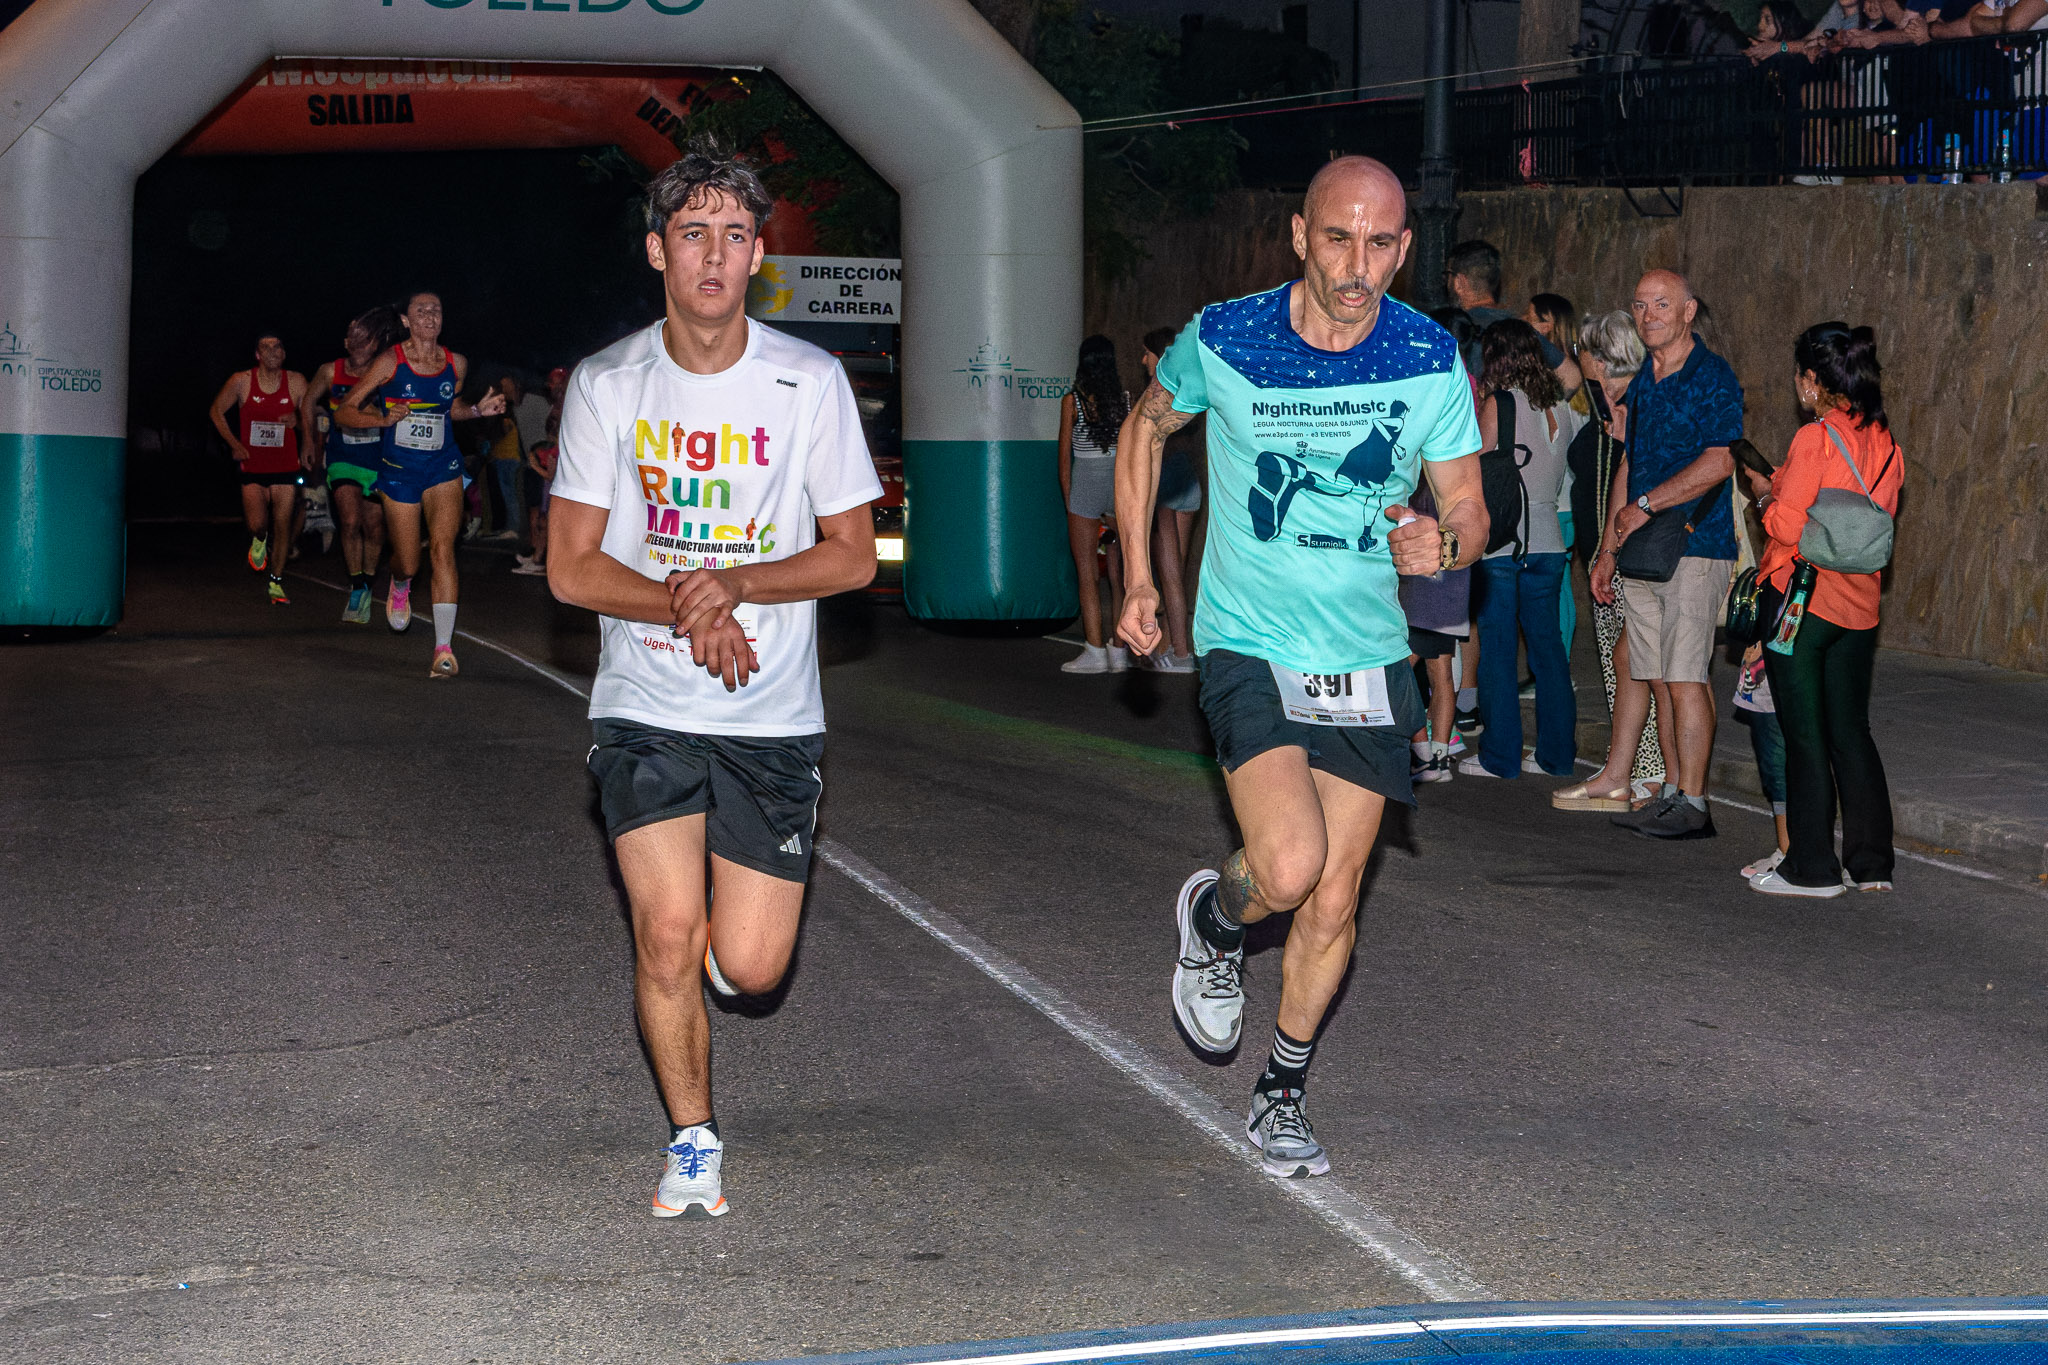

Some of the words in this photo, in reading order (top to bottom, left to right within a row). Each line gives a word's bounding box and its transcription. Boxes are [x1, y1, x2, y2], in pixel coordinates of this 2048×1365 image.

[308, 94, 414, 126] SALIDA
[801, 264, 901, 281] DIRECCIÓN
[839, 284, 863, 297] DE
[808, 301, 893, 315] CARRERA
[40, 376, 102, 392] TOLEDO
[1252, 400, 1386, 418] NightRunMusic
[410, 424, 433, 438] 239
[635, 419, 770, 471] Night
[637, 464, 731, 509] Run
[675, 539, 723, 554] NOCTURNA
[725, 543, 755, 553] UGENA
[1303, 672, 1353, 698] 391
